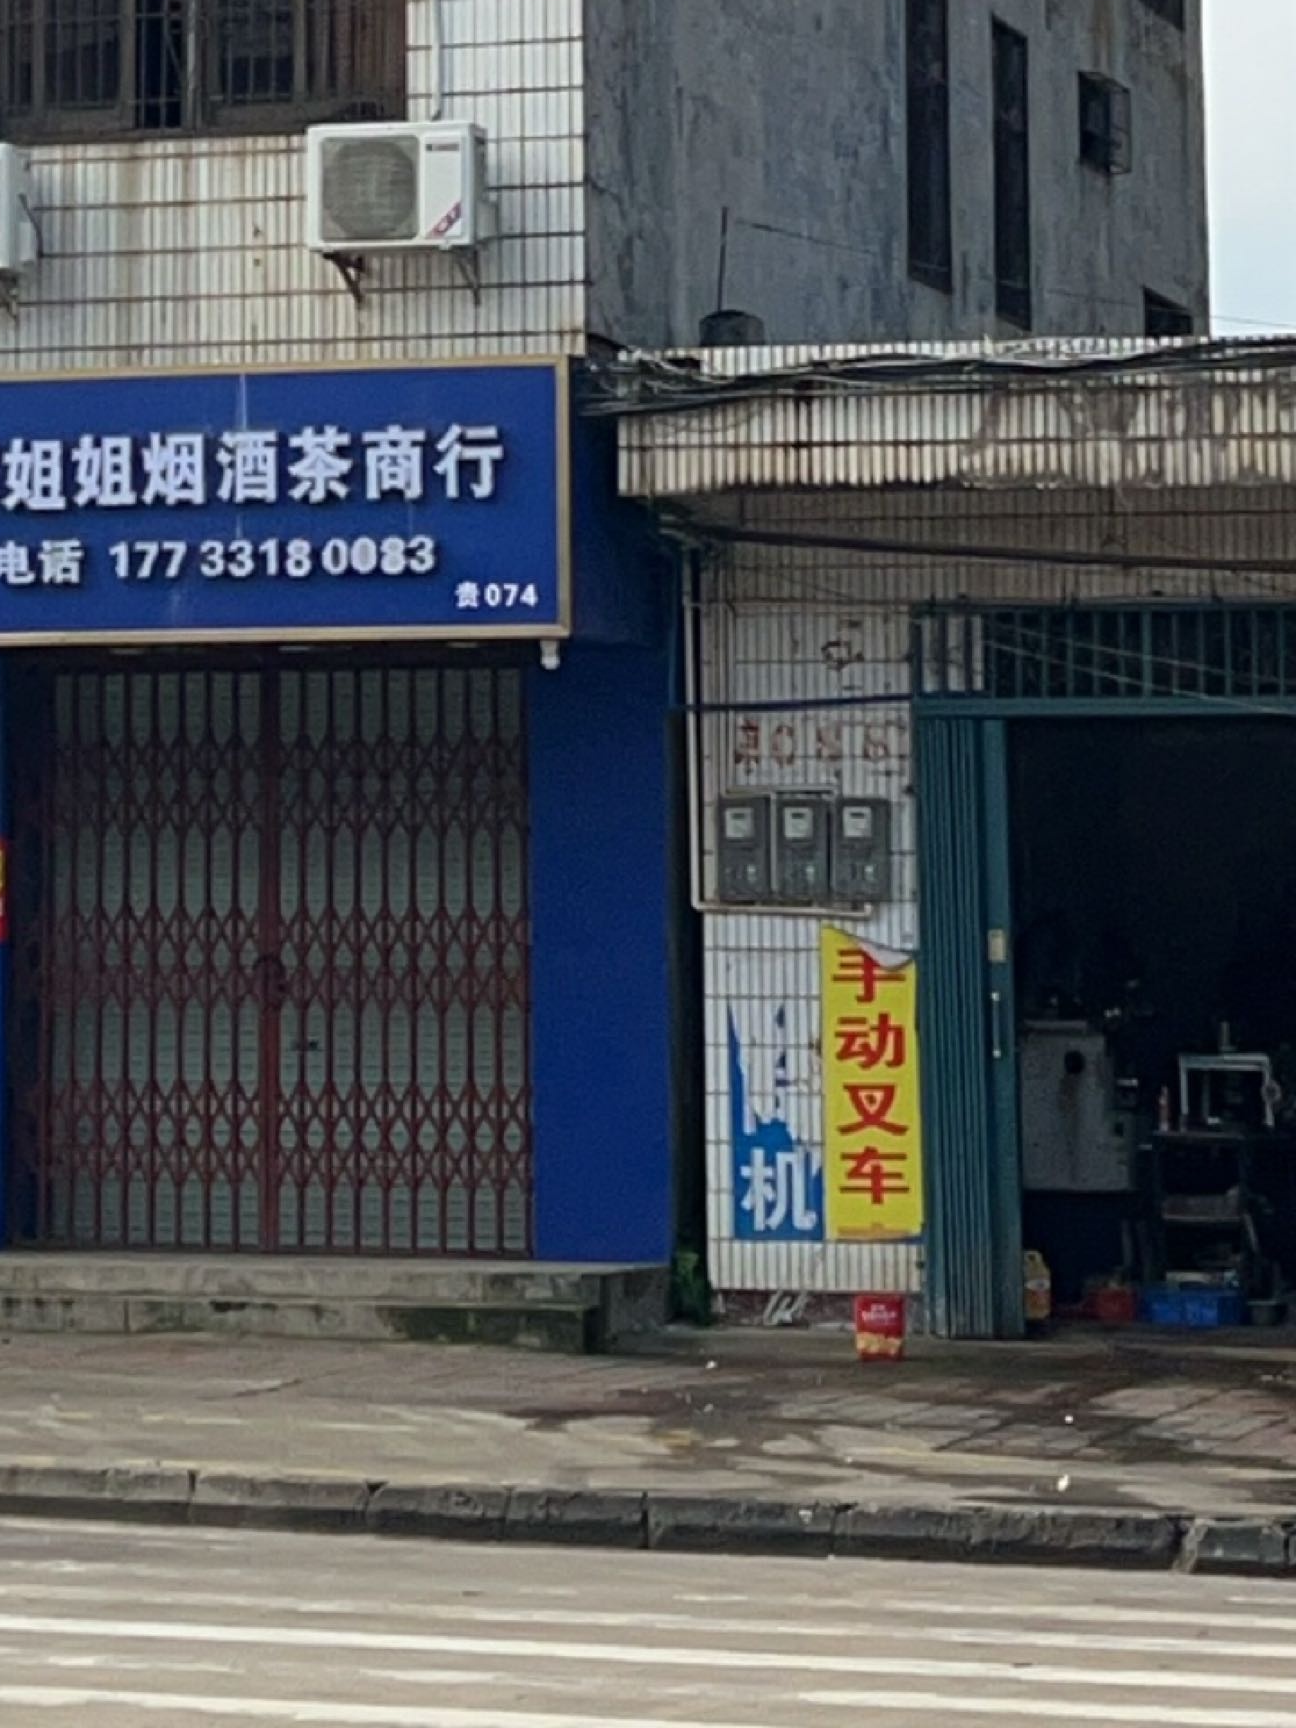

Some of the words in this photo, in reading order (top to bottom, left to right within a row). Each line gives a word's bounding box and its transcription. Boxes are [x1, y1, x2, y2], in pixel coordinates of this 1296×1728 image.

[455, 580, 540, 610] 贵074
[832, 948, 911, 1205] 手动叉车
